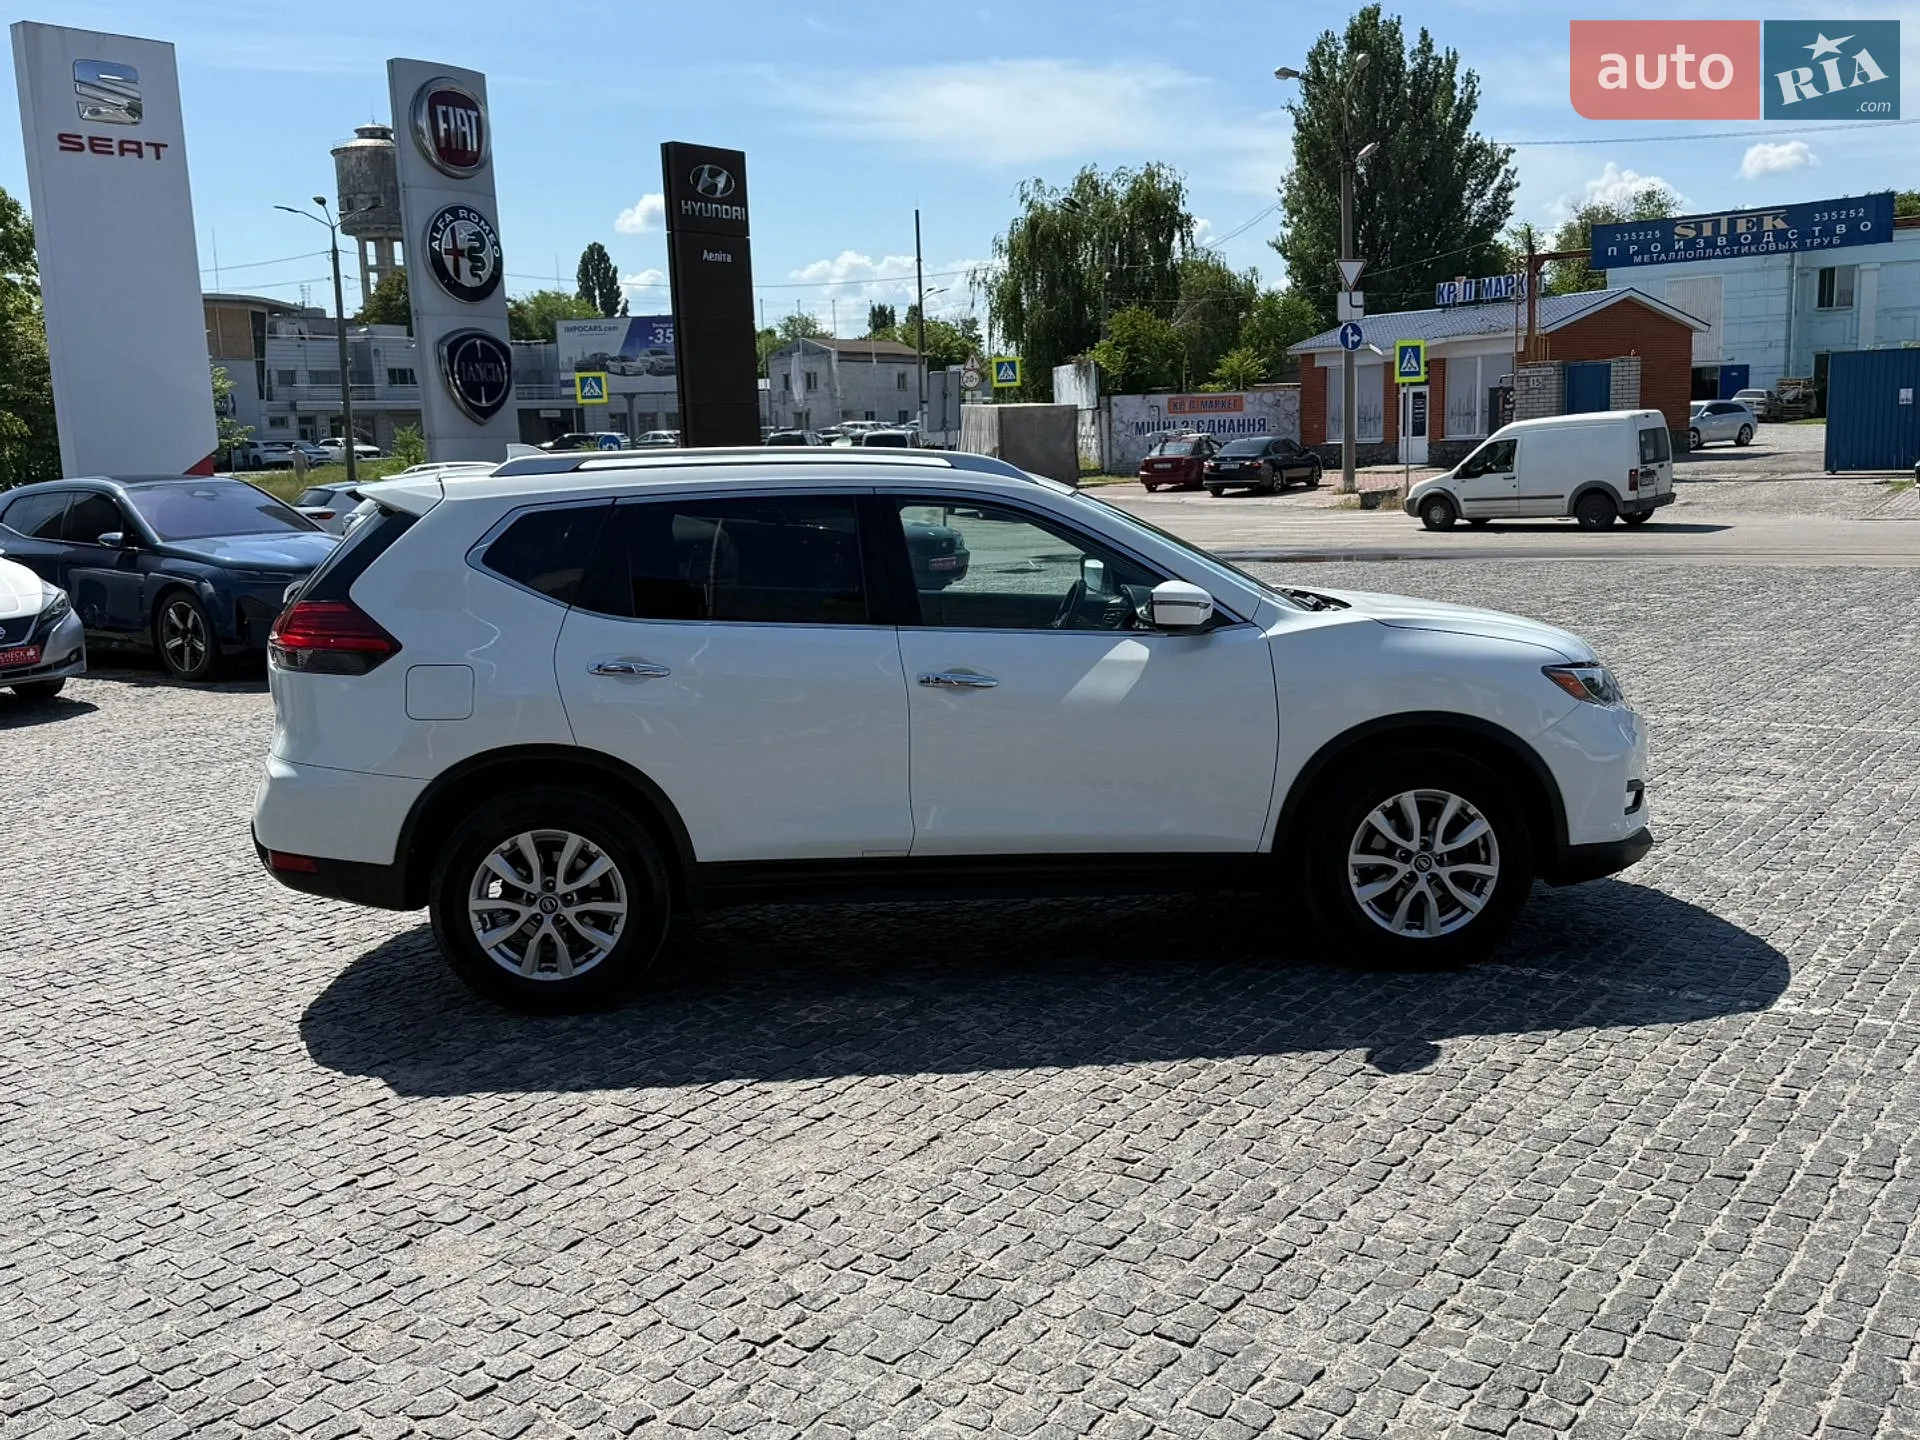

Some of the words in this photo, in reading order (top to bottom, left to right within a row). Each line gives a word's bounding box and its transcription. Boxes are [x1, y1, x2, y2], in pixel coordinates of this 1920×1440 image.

[436, 104, 478, 151] FIAT
[57, 133, 168, 160] SEAT
[681, 200, 746, 220] HYUNDAI
[1813, 208, 1865, 222] 335252
[431, 213, 455, 251] ALFA
[458, 209, 500, 258] ROMEO
[1607, 221, 1872, 256] ПРОИЗВОДСТВО
[1615, 230, 1660, 241] 335225
[1633, 241, 1798, 263] МЕТАЛЛОПЛАСТИКОВЫХ
[1805, 236, 1841, 248] ТРУБ
